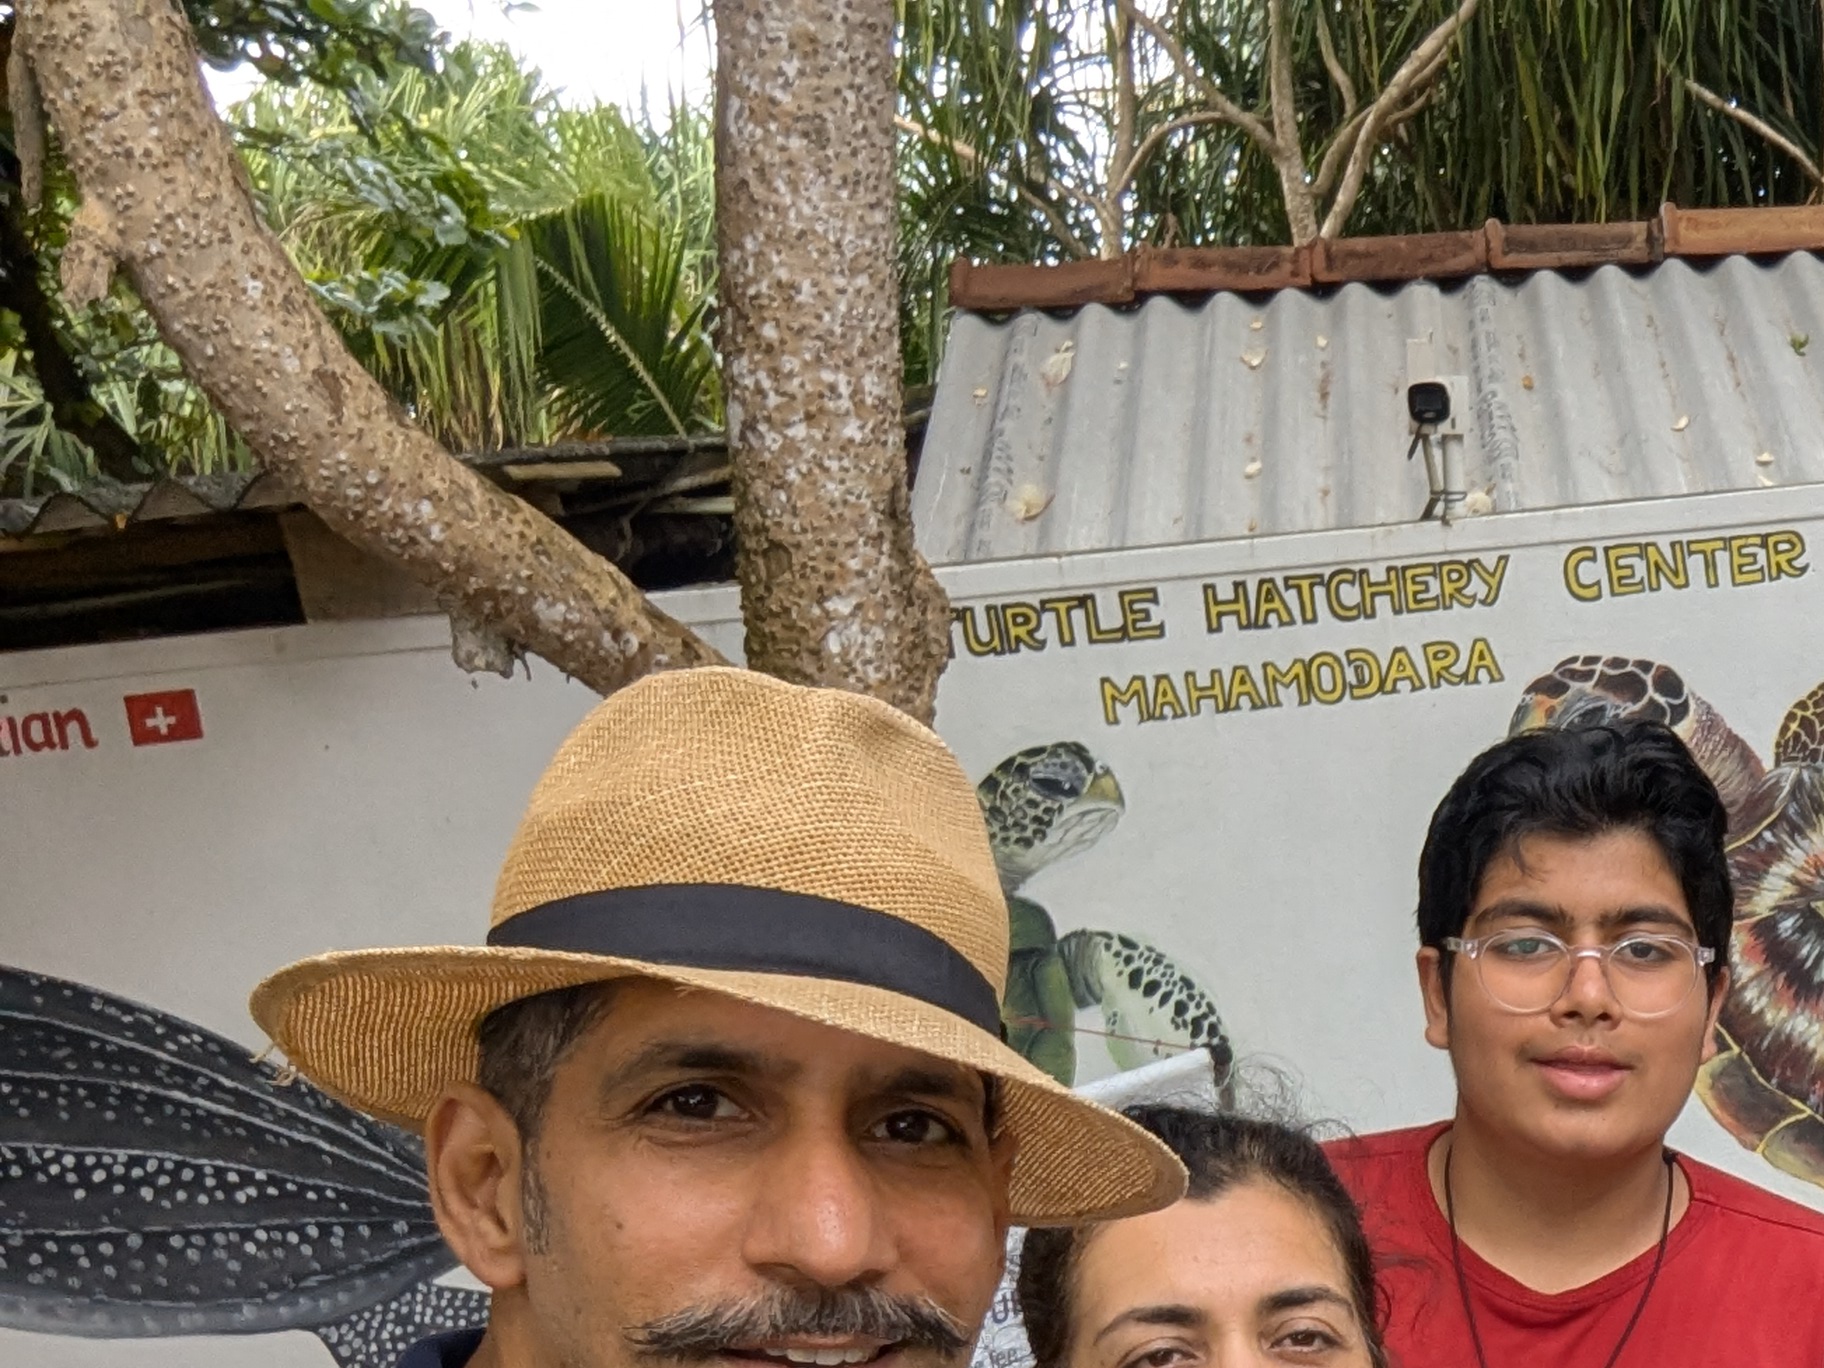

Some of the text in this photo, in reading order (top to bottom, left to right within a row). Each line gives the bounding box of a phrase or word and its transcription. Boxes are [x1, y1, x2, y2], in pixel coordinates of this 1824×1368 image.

[1201, 555, 1510, 634] HATCHERY
[1563, 530, 1811, 602] CENTER
[1099, 637, 1505, 725] MAHAMODARA
